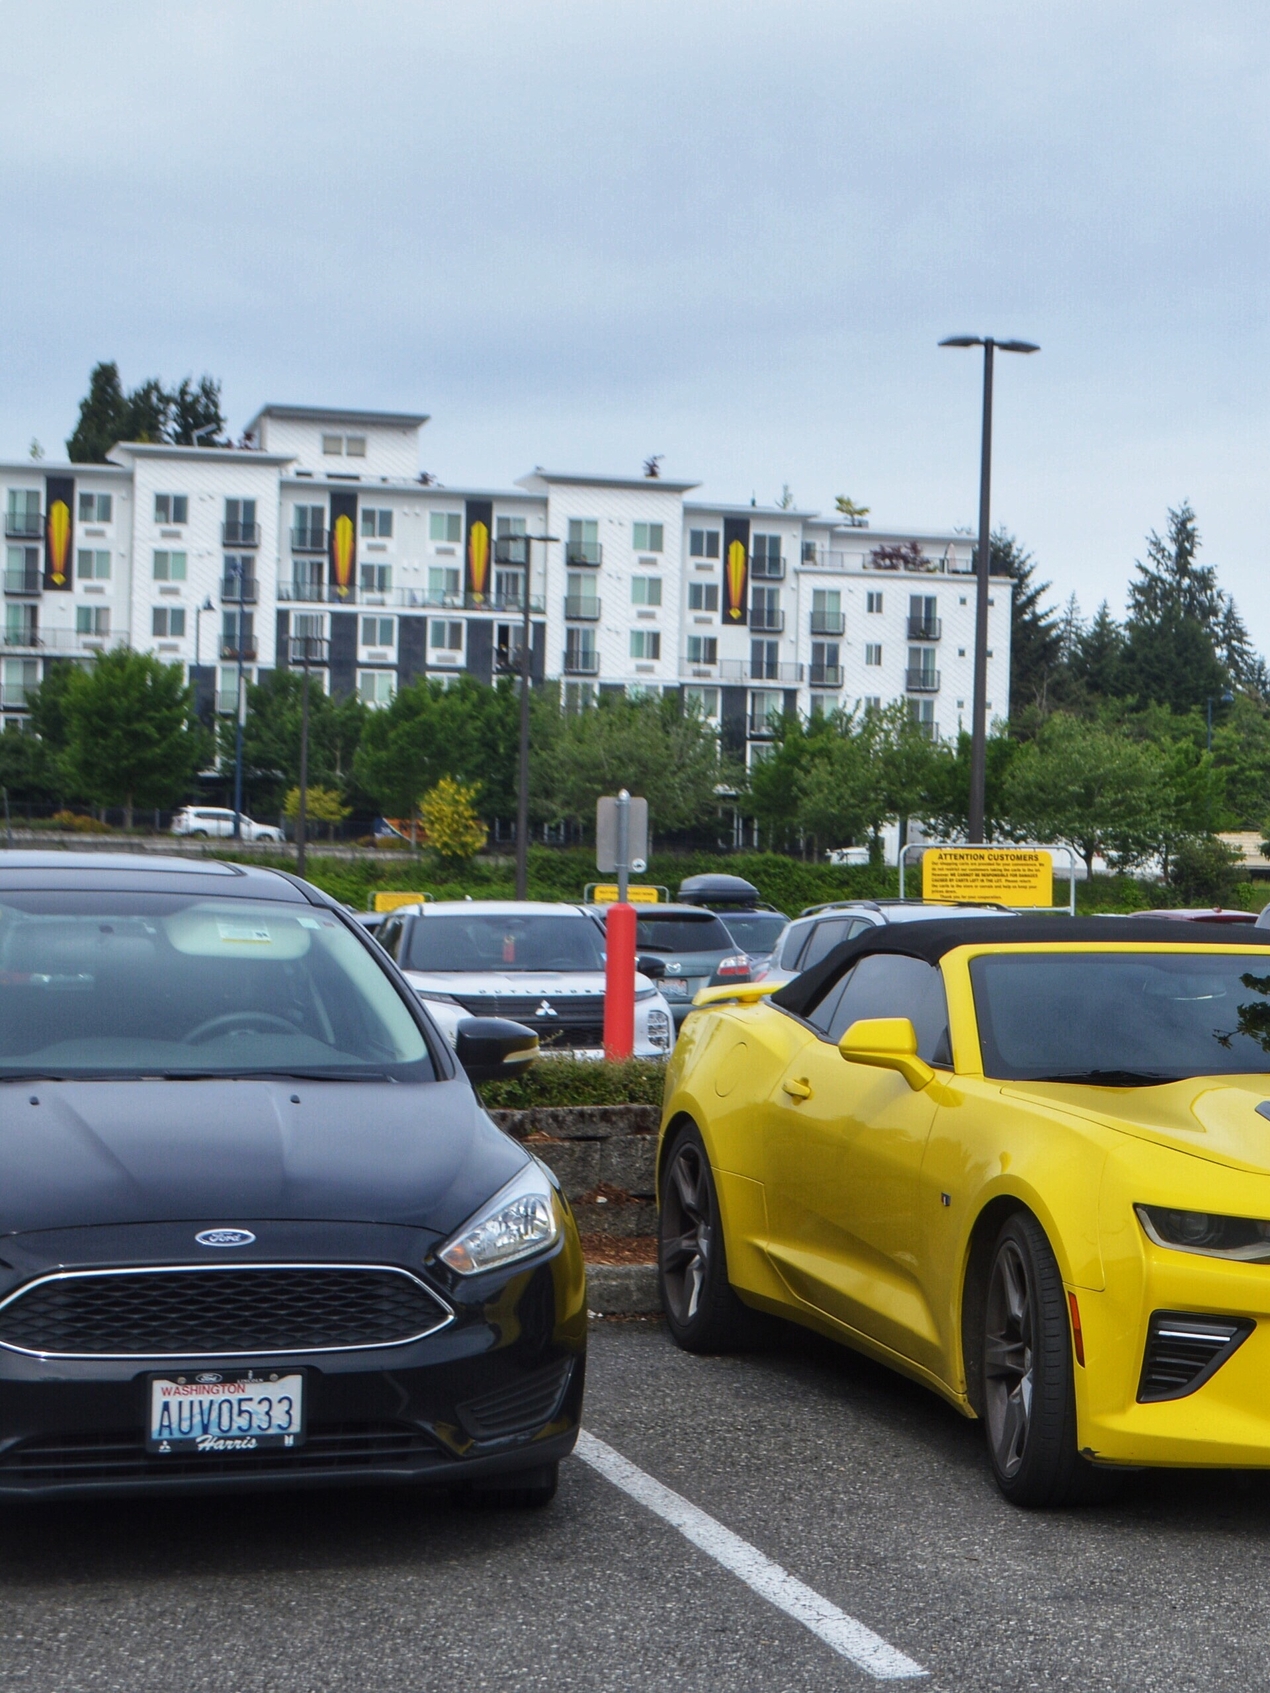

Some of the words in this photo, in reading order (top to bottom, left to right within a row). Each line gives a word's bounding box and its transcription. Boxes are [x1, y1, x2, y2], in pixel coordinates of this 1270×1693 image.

[209, 1232, 241, 1242] Ford
[161, 1384, 246, 1396] WASHINGTON
[158, 1396, 293, 1436] AUV0533
[196, 1434, 258, 1450] Harris
